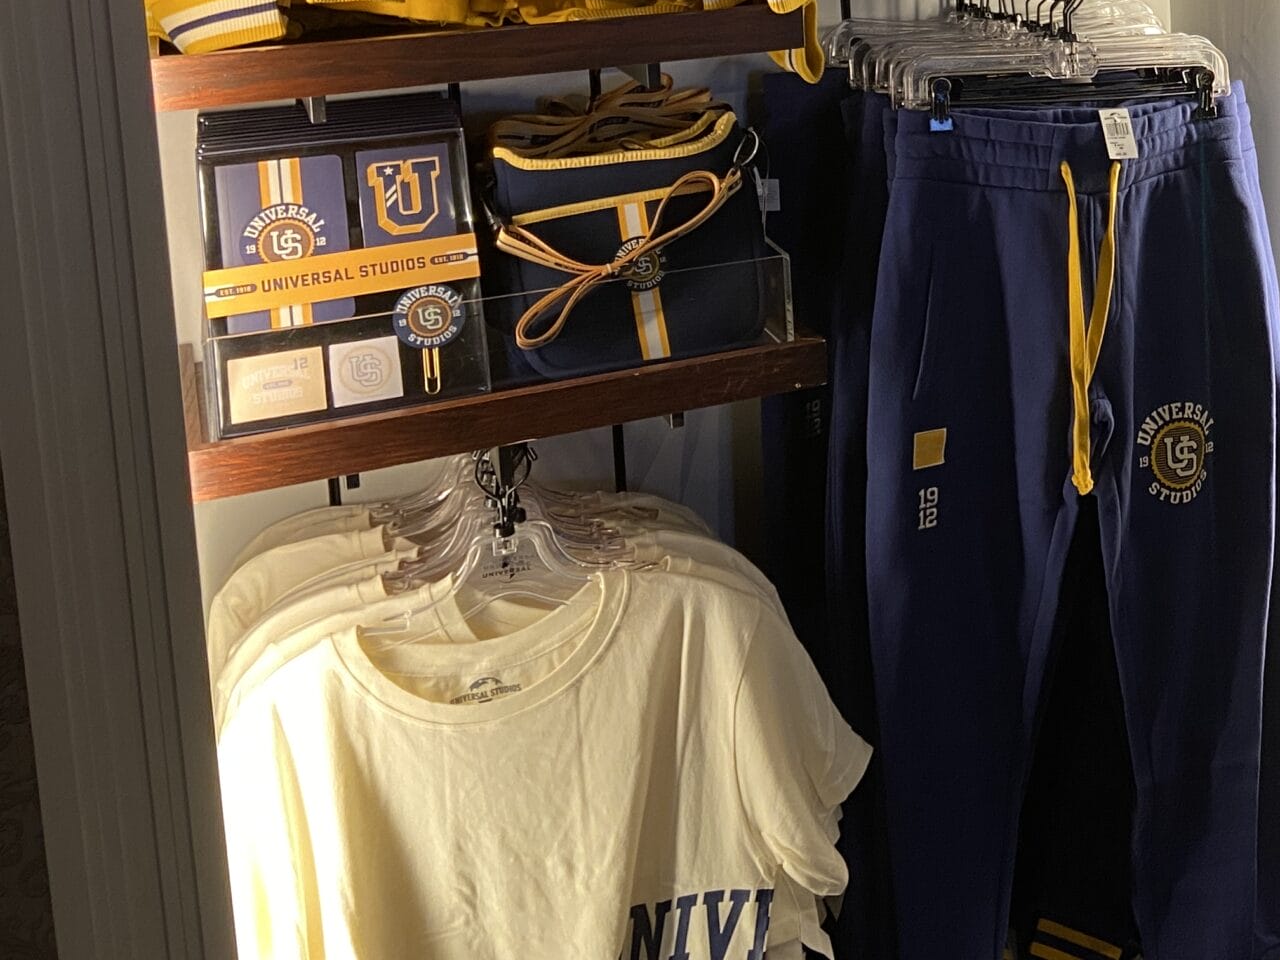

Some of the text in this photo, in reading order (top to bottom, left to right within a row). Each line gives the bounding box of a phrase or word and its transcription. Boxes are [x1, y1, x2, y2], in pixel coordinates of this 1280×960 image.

[243, 204, 325, 239] UNIVERSAL
[261, 267, 354, 292] UNIVERSAL
[359, 256, 426, 278] STUDIOS
[396, 286, 460, 314] UNIVERSAL
[408, 325, 458, 346] STUDIOS
[1136, 401, 1216, 447] UNIVERSAL
[918, 486, 939, 509] 19
[1148, 470, 1207, 504] STUDIOS
[918, 508, 938, 530] 12
[490, 683, 522, 696] STUDIOS
